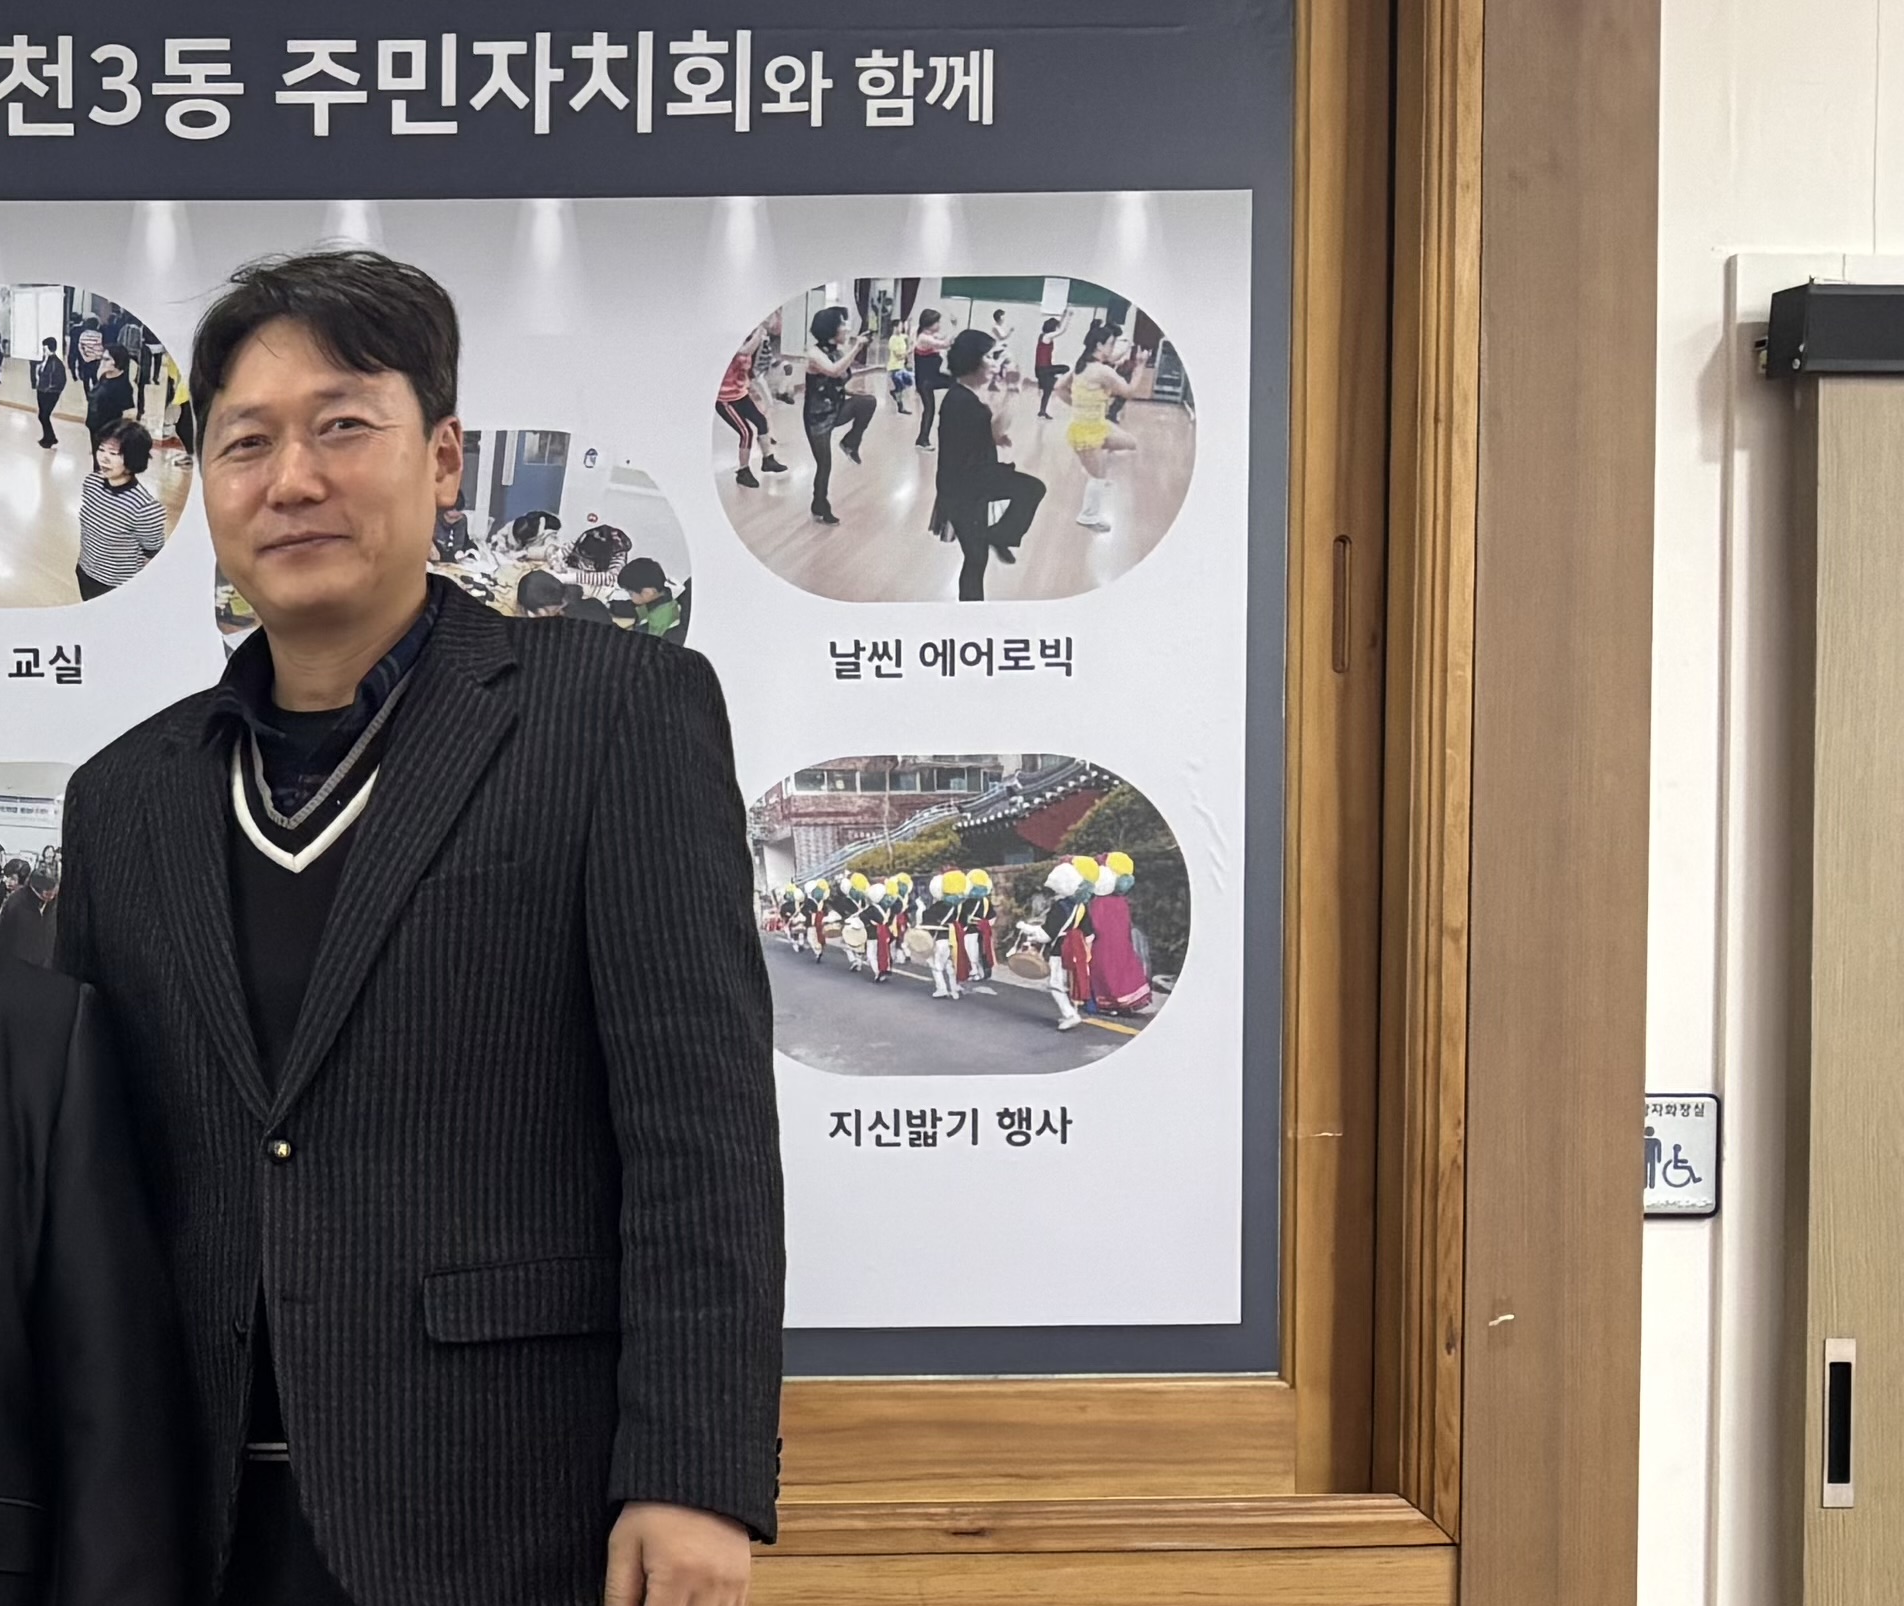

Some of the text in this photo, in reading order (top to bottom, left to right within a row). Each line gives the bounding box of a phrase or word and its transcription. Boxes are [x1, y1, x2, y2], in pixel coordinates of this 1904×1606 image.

[276, 30, 833, 136] 주민자치회와
[856, 49, 993, 126] 함께
[8, 645, 82, 684] 교실
[830, 637, 1072, 679] 날씬 에어로빅
[829, 1107, 1072, 1147] 지신밟기 행사
